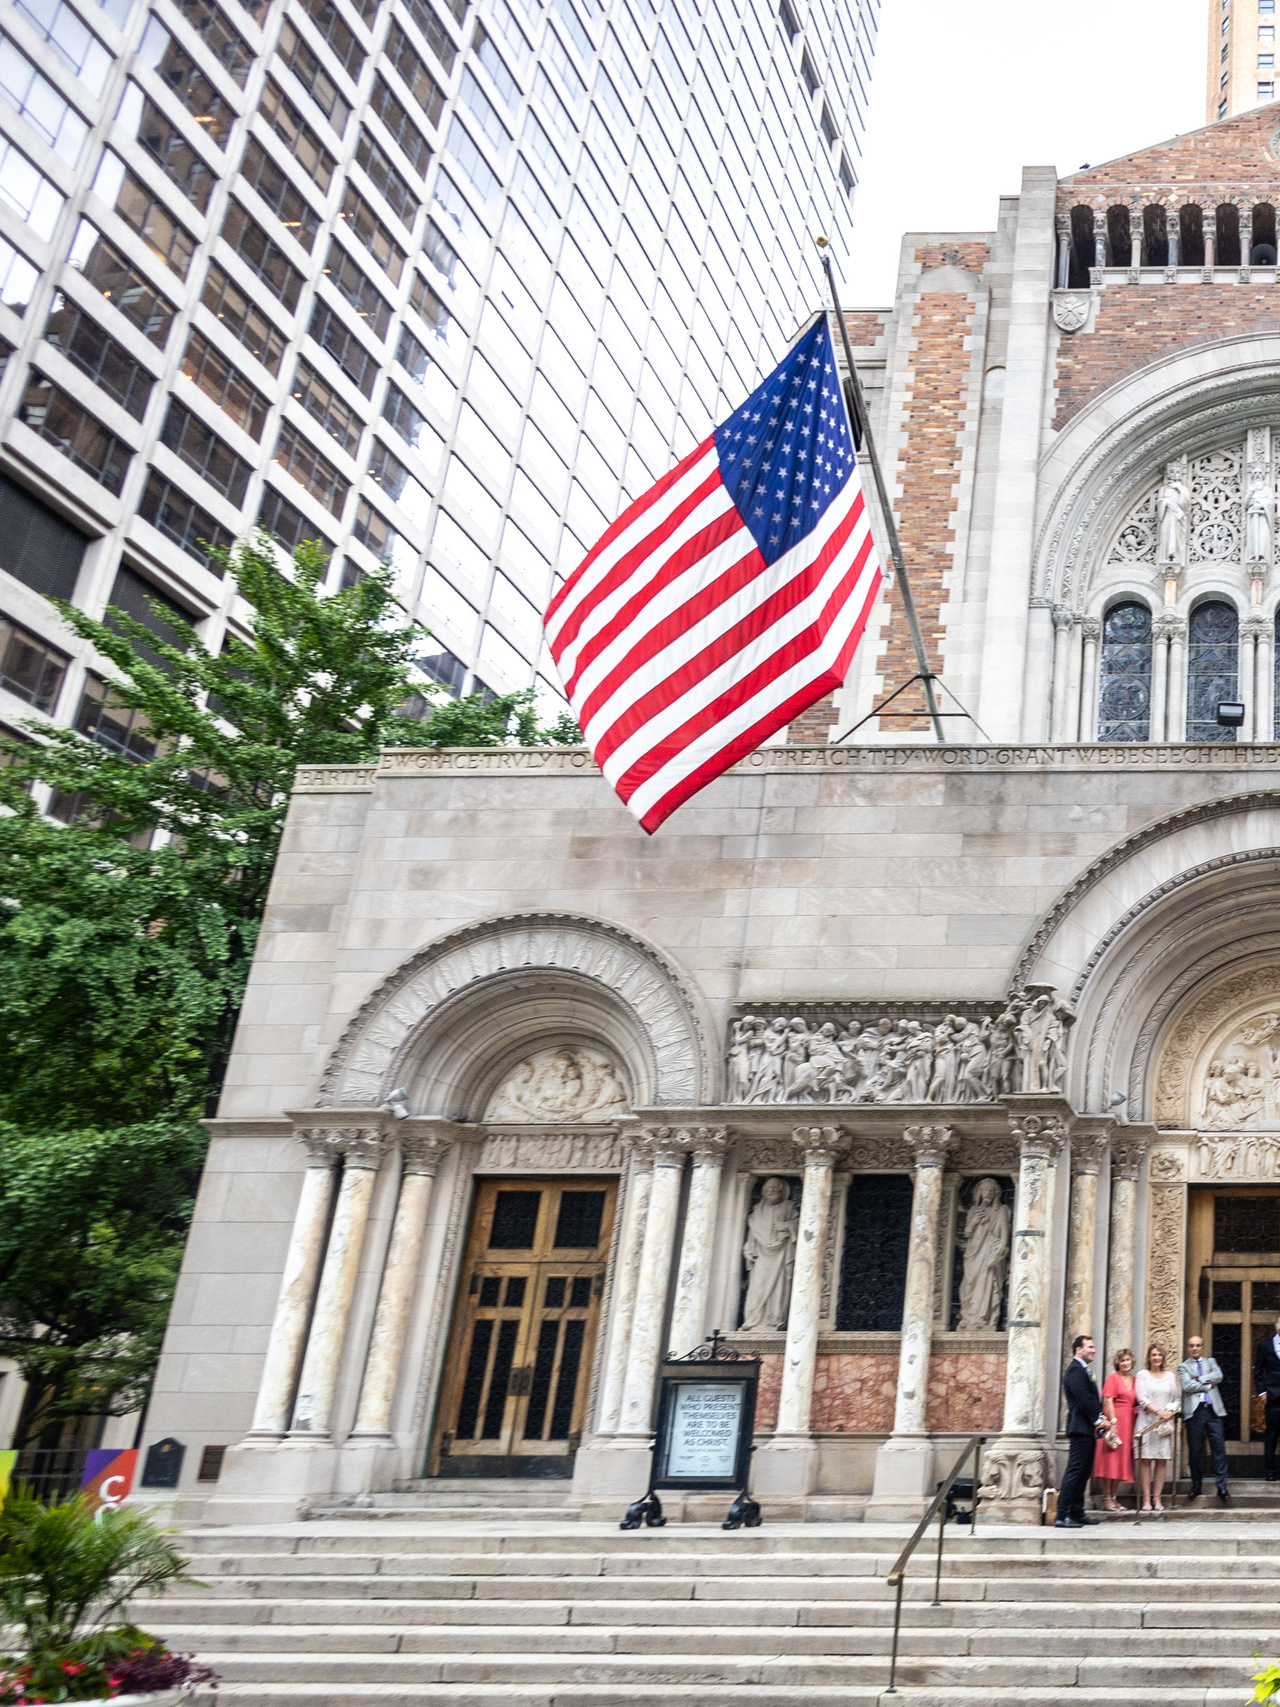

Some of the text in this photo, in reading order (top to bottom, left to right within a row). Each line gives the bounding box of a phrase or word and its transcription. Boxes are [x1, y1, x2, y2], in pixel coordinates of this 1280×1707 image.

[414, 753, 480, 769] GRACE
[483, 753, 556, 768] TRVLY
[558, 753, 588, 768] TO
[771, 750, 860, 766] PREACH
[868, 750, 912, 765] THY
[922, 750, 989, 765] WORD
[996, 749, 1071, 764] GRANT
[1077, 749, 1109, 763] WE
[1114, 748, 1212, 763] BESEECH
[1217, 748, 1277, 763] THEE
[686, 1394, 737, 1402] ALL GUESTS
[703, 1403, 741, 1411] PRESENT
[682, 1412, 737, 1420] THEMSELVES
[686, 1421, 731, 1429] ARE TO BE
[683, 1438, 696, 1446] AS
